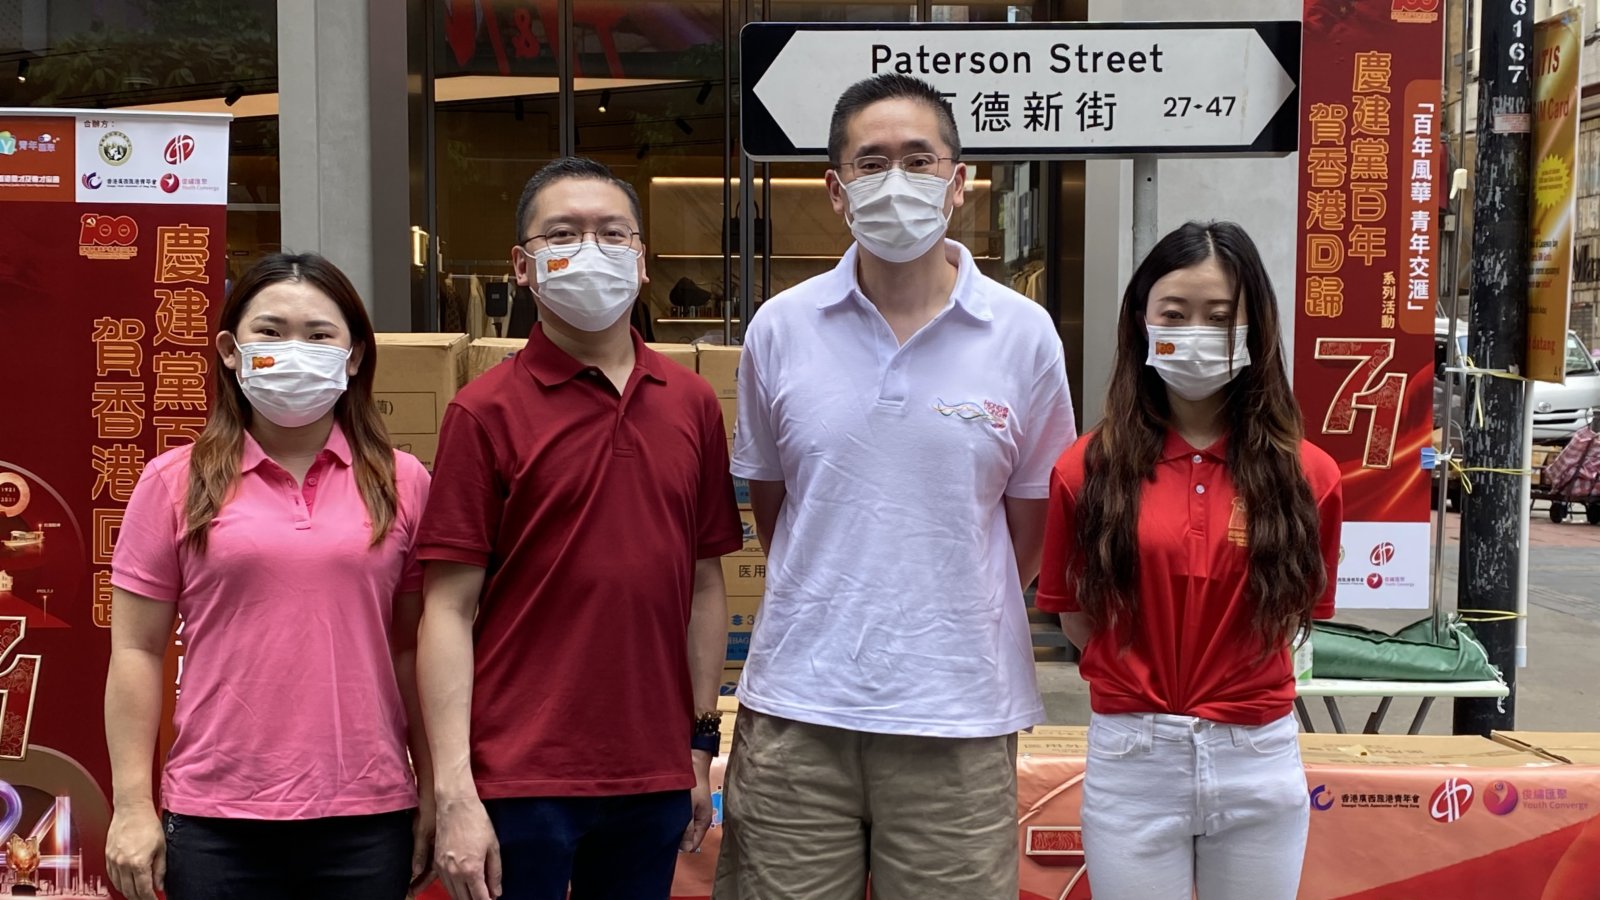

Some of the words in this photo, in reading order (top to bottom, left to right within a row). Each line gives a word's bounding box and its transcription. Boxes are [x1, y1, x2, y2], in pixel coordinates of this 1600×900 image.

[871, 44, 1031, 75] Paterson
[1049, 43, 1164, 73] Street
[941, 90, 1118, 133] 德新街
[1163, 96, 1237, 117] 27-47
[1548, 91, 1570, 120] Card
[1349, 50, 1392, 266] 慶建黨百年
[1380, 270, 1397, 330] 系列活動
[738, 564, 767, 579] 医用
